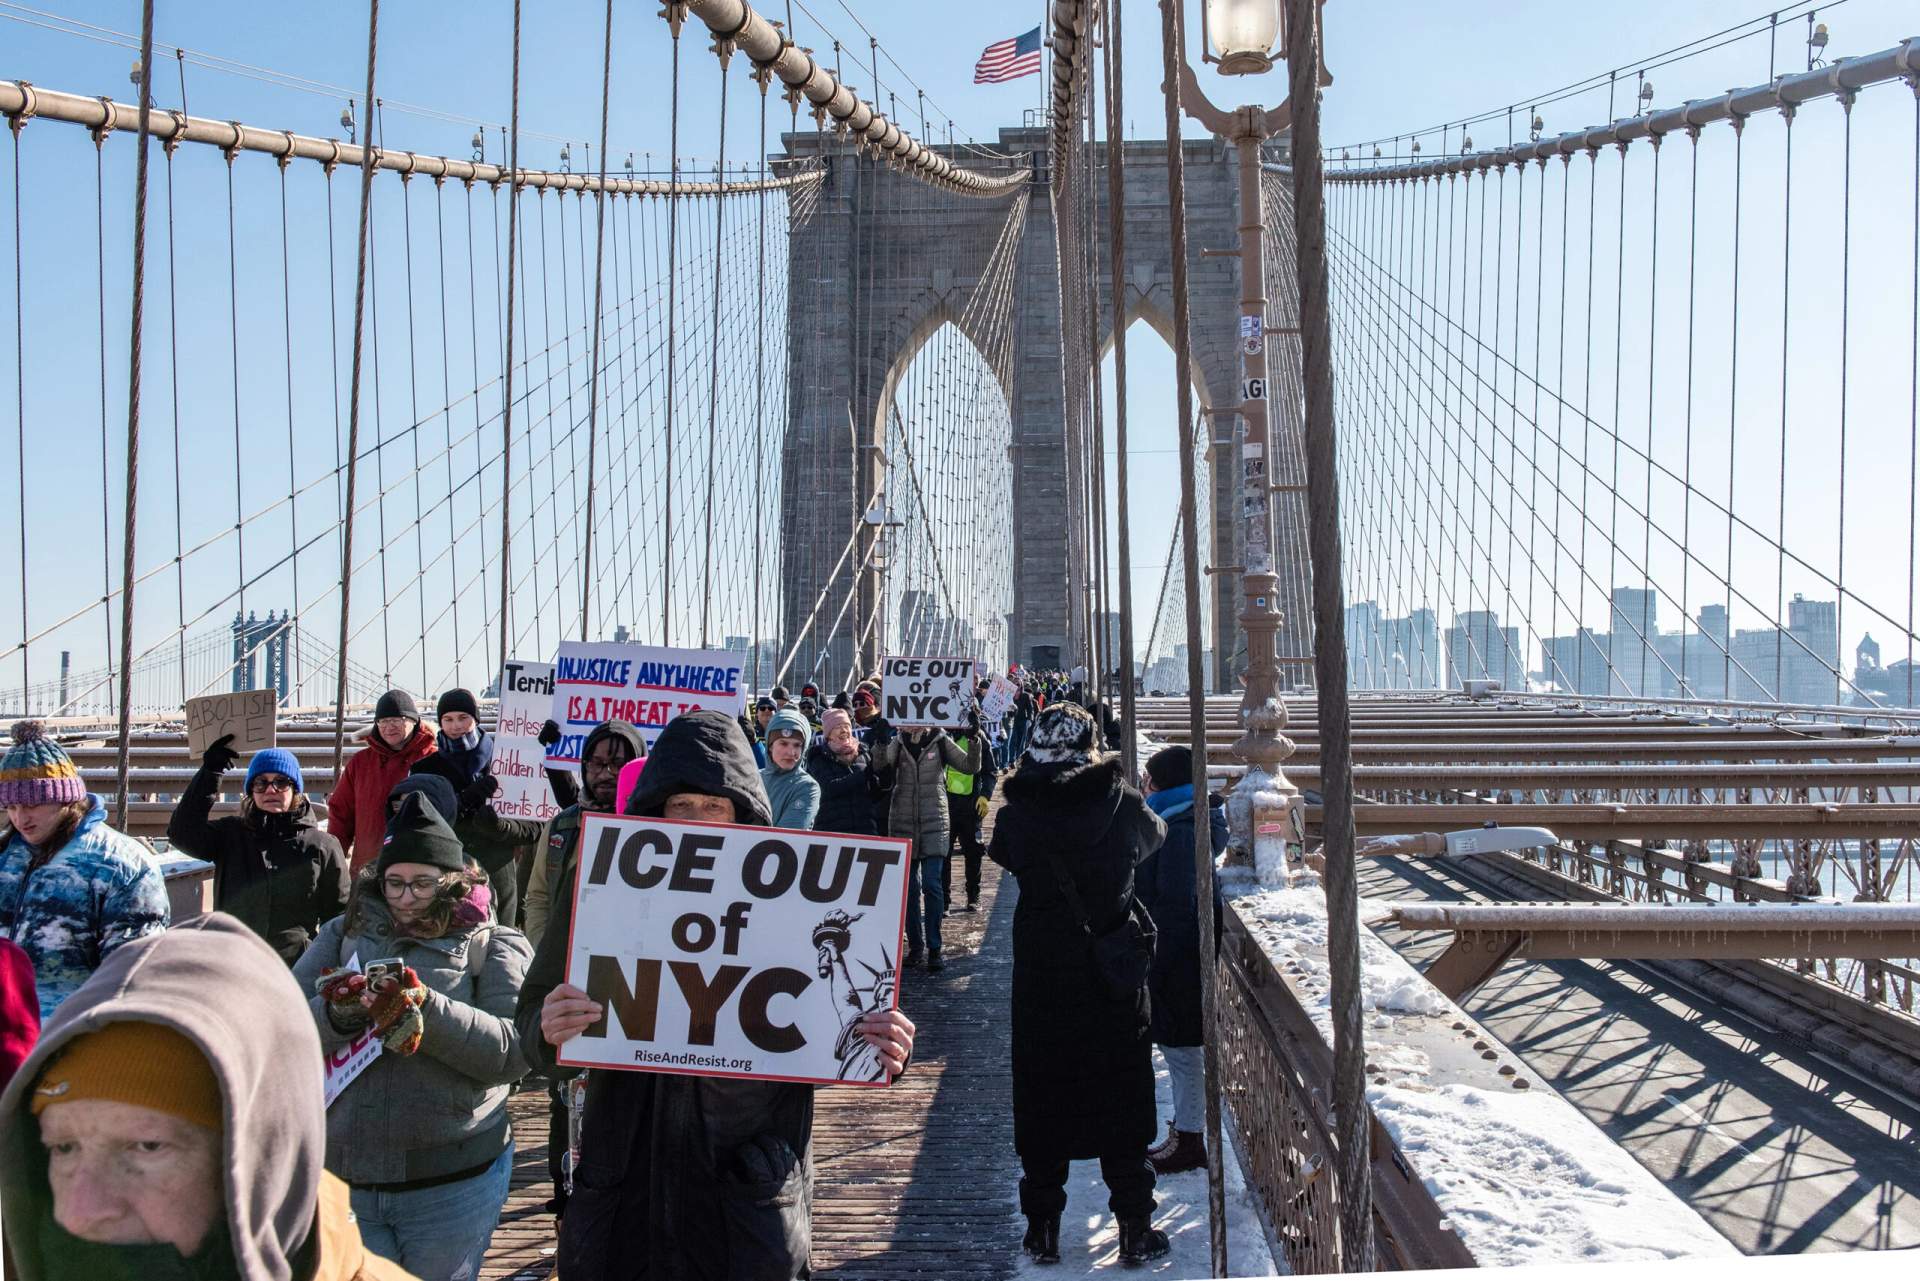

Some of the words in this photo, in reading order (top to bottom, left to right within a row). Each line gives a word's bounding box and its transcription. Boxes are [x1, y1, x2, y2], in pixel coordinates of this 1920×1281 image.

[557, 657, 632, 685] INJUSTICE
[637, 662, 740, 692] ANYWHERE
[885, 659, 922, 677] ICE
[928, 660, 972, 678] OUT
[909, 679, 932, 694] of
[190, 694, 275, 730] ABOLISH
[567, 696, 582, 720] IS
[584, 698, 597, 721] A
[602, 697, 672, 726] THREAT
[886, 695, 951, 720] NYC
[588, 826, 725, 894] ICE
[741, 839, 901, 907] OUT
[671, 901, 752, 955] of
[581, 954, 813, 1053] NYC
[634, 1049, 753, 1071] RiseAndResist.org
